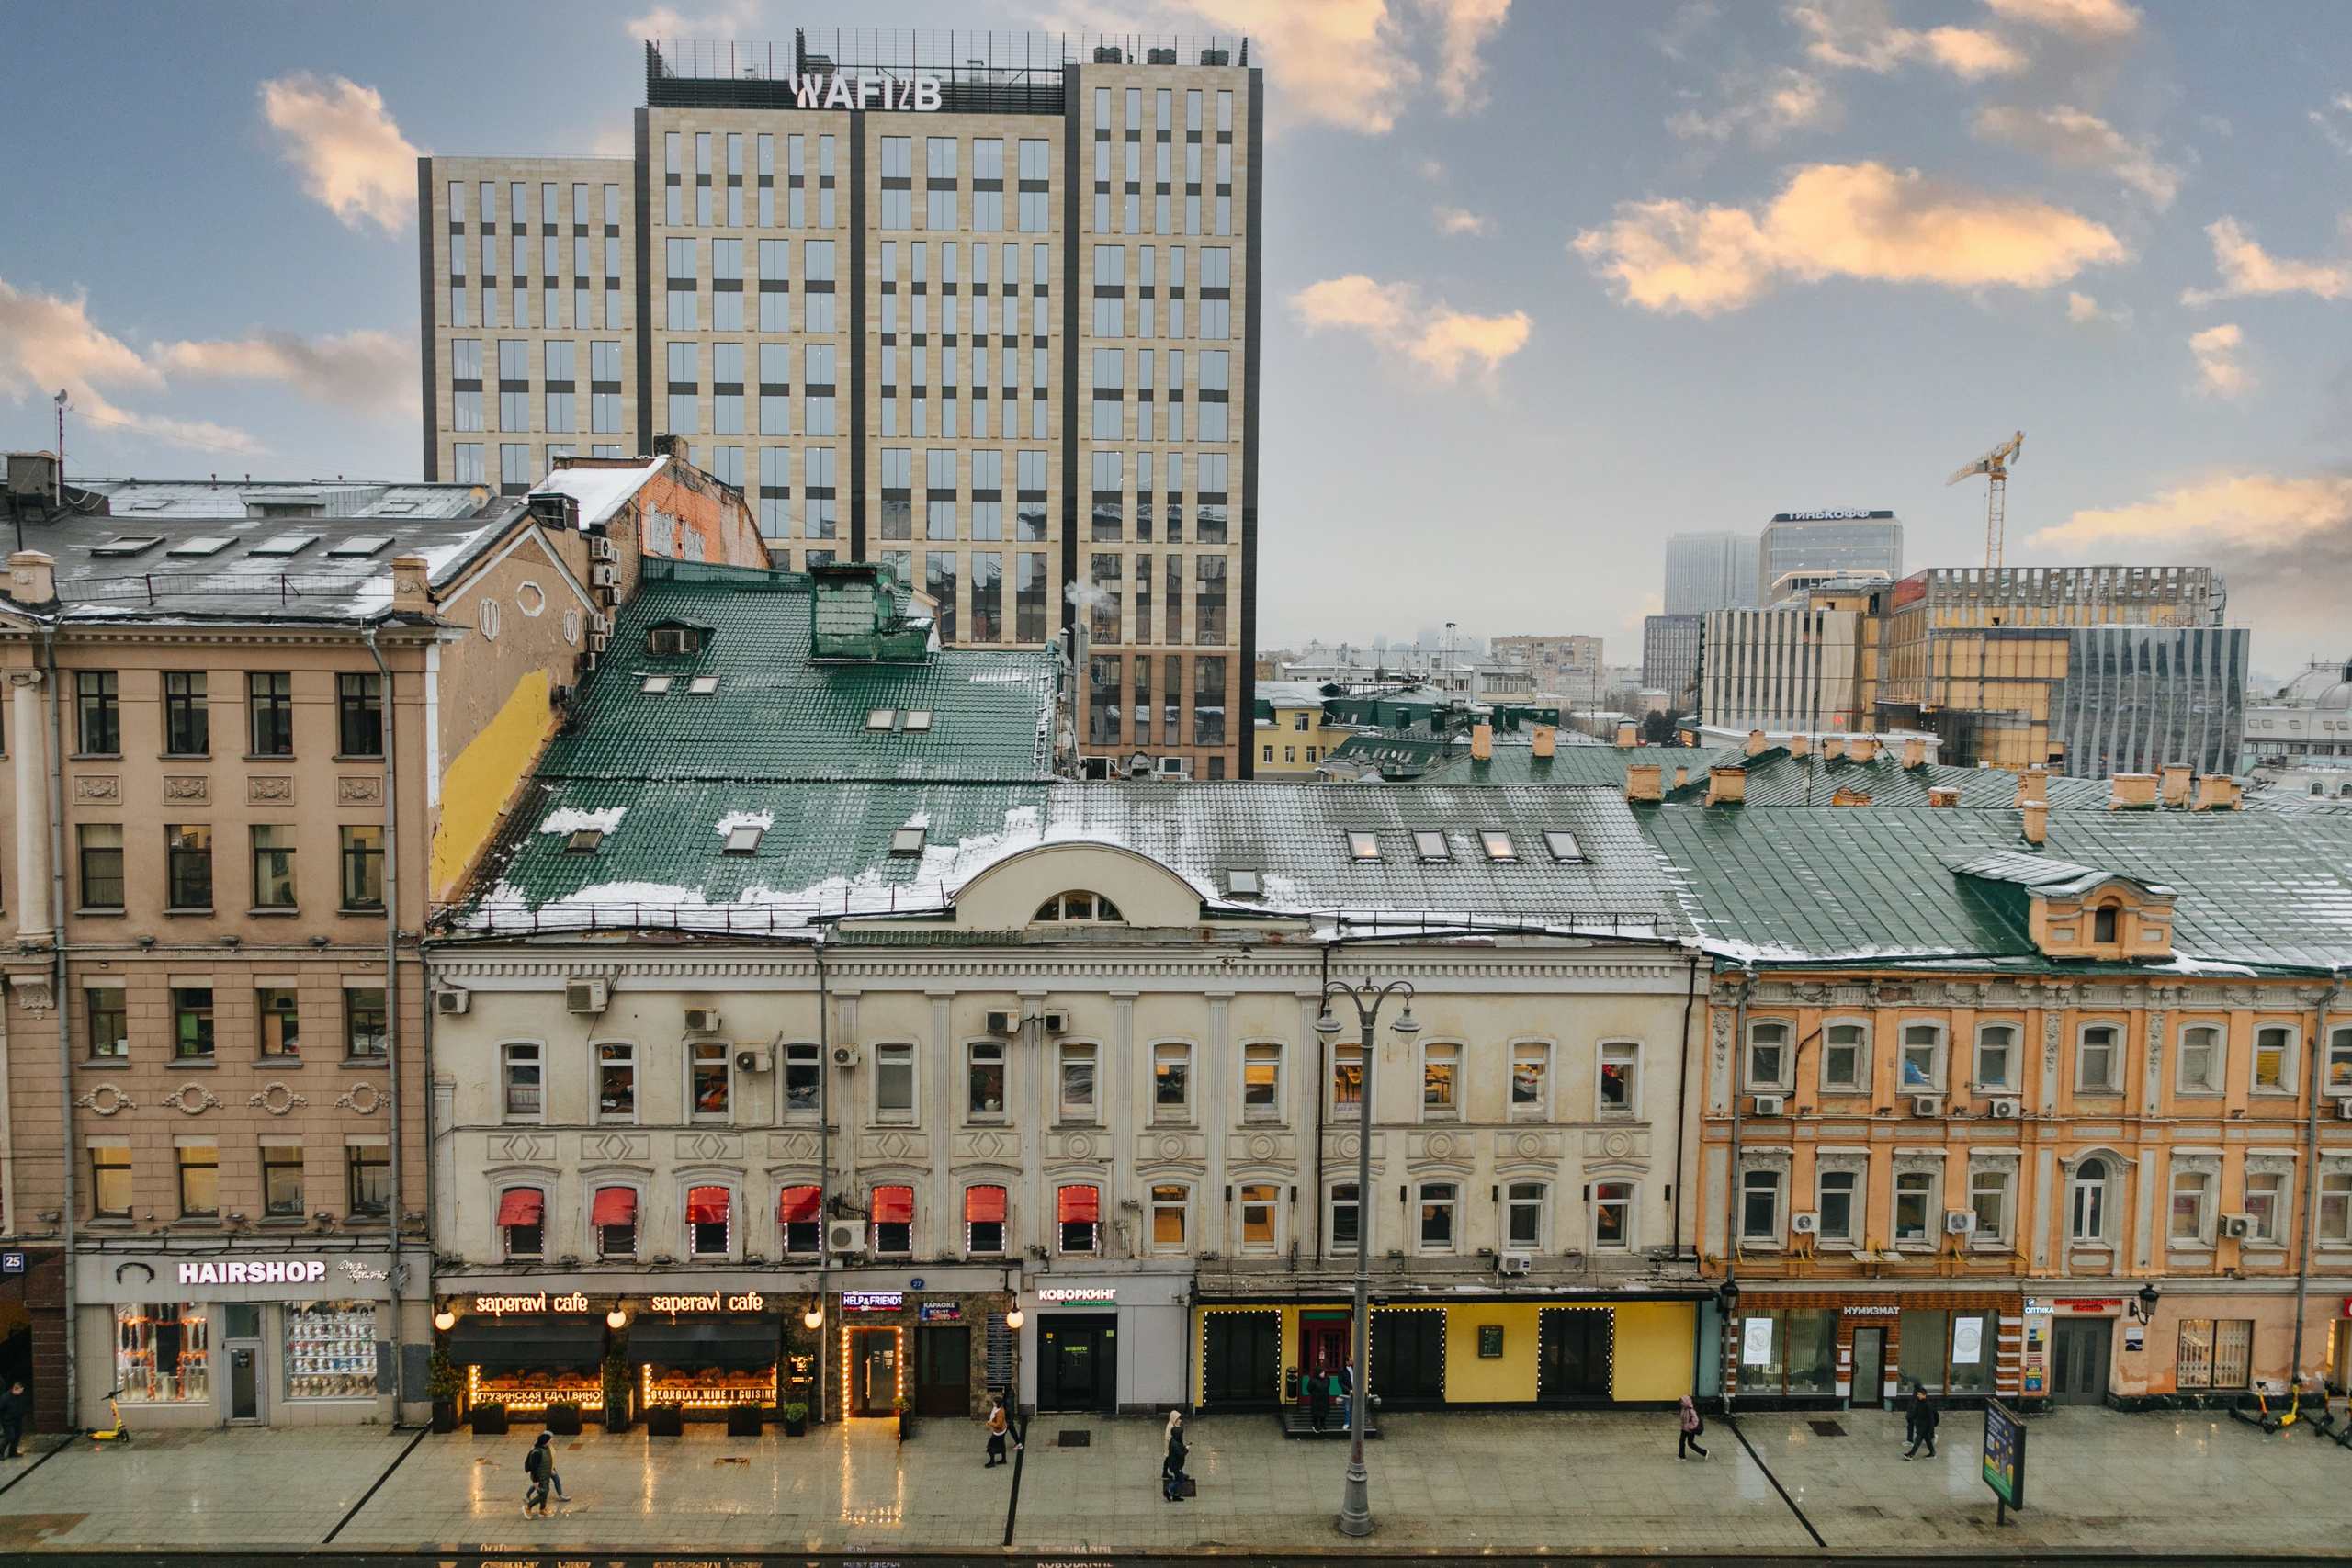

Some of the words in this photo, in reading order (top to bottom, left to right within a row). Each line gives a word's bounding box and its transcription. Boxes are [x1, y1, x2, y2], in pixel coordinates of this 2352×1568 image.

[6, 1256, 21, 1267] 25
[1038, 1289, 1116, 1300] КОВОРКИНГ
[476, 1290, 547, 1317] saperavi
[553, 1292, 589, 1312] cafe
[651, 1290, 721, 1316] saperavi
[729, 1291, 763, 1311] cafe
[1843, 1306, 1901, 1315] НУМИЗМАТ
[478, 1392, 542, 1401] ГРУЗИНСКАЯ
[544, 1392, 564, 1401] ЕДА
[571, 1391, 601, 1400] ВИНО
[650, 1389, 698, 1400] GEORGIAN
[702, 1390, 727, 1399] WINE
